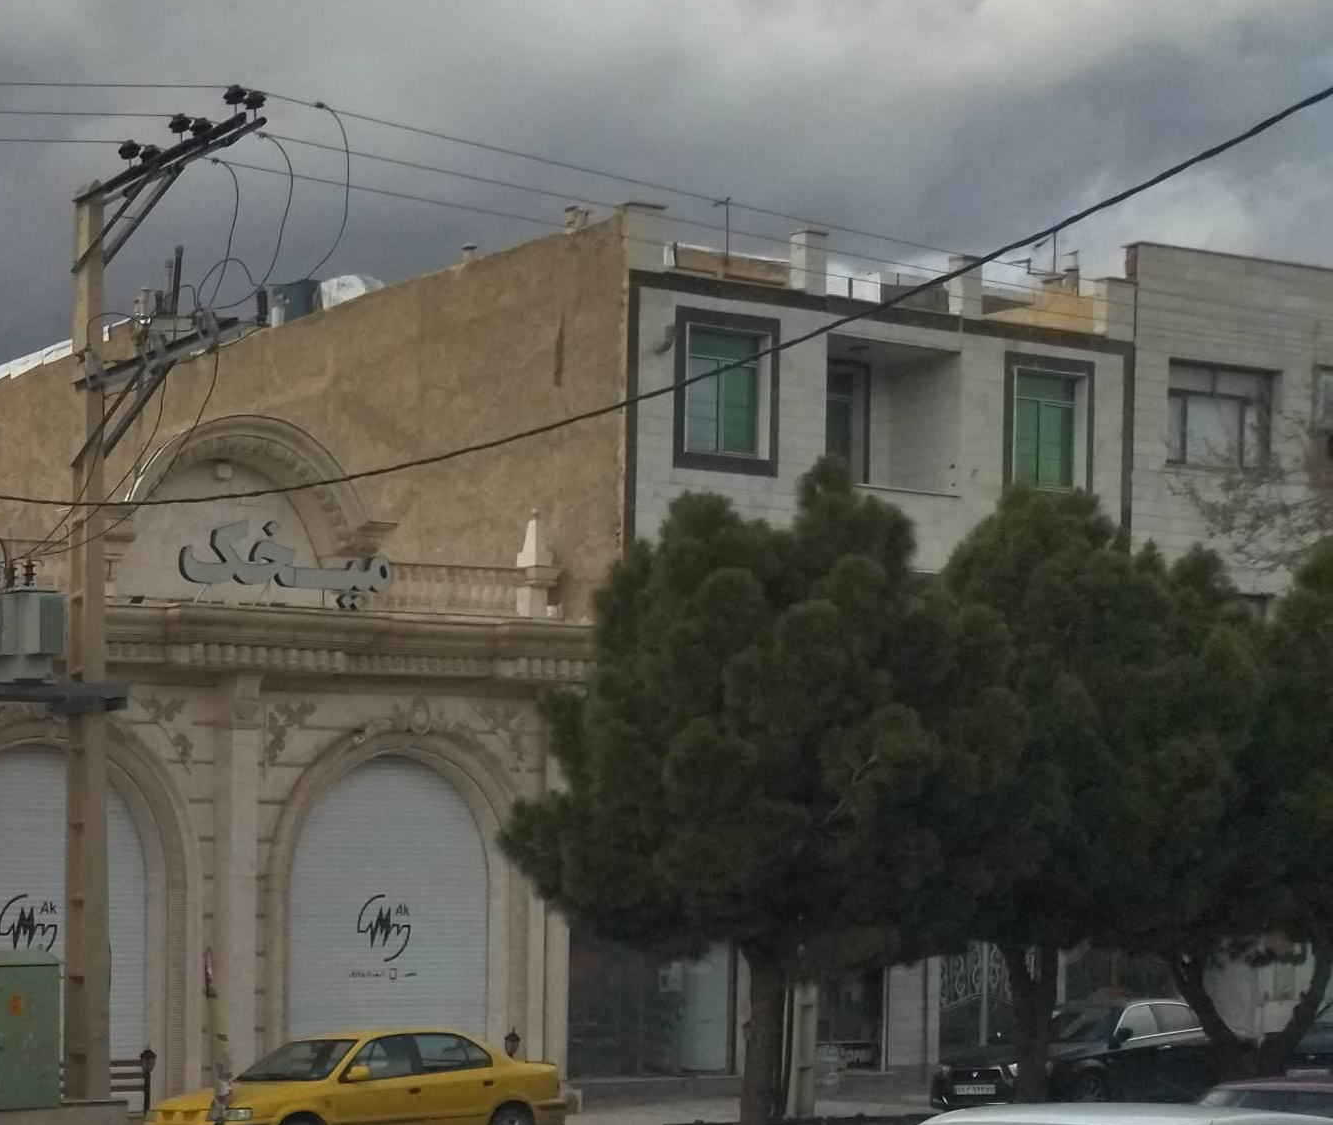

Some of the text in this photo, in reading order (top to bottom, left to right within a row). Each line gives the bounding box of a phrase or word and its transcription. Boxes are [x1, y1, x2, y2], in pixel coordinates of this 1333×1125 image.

[178, 519, 393, 611] میخک
[40, 901, 58, 914] Ak
[395, 904, 410, 916] Ak
